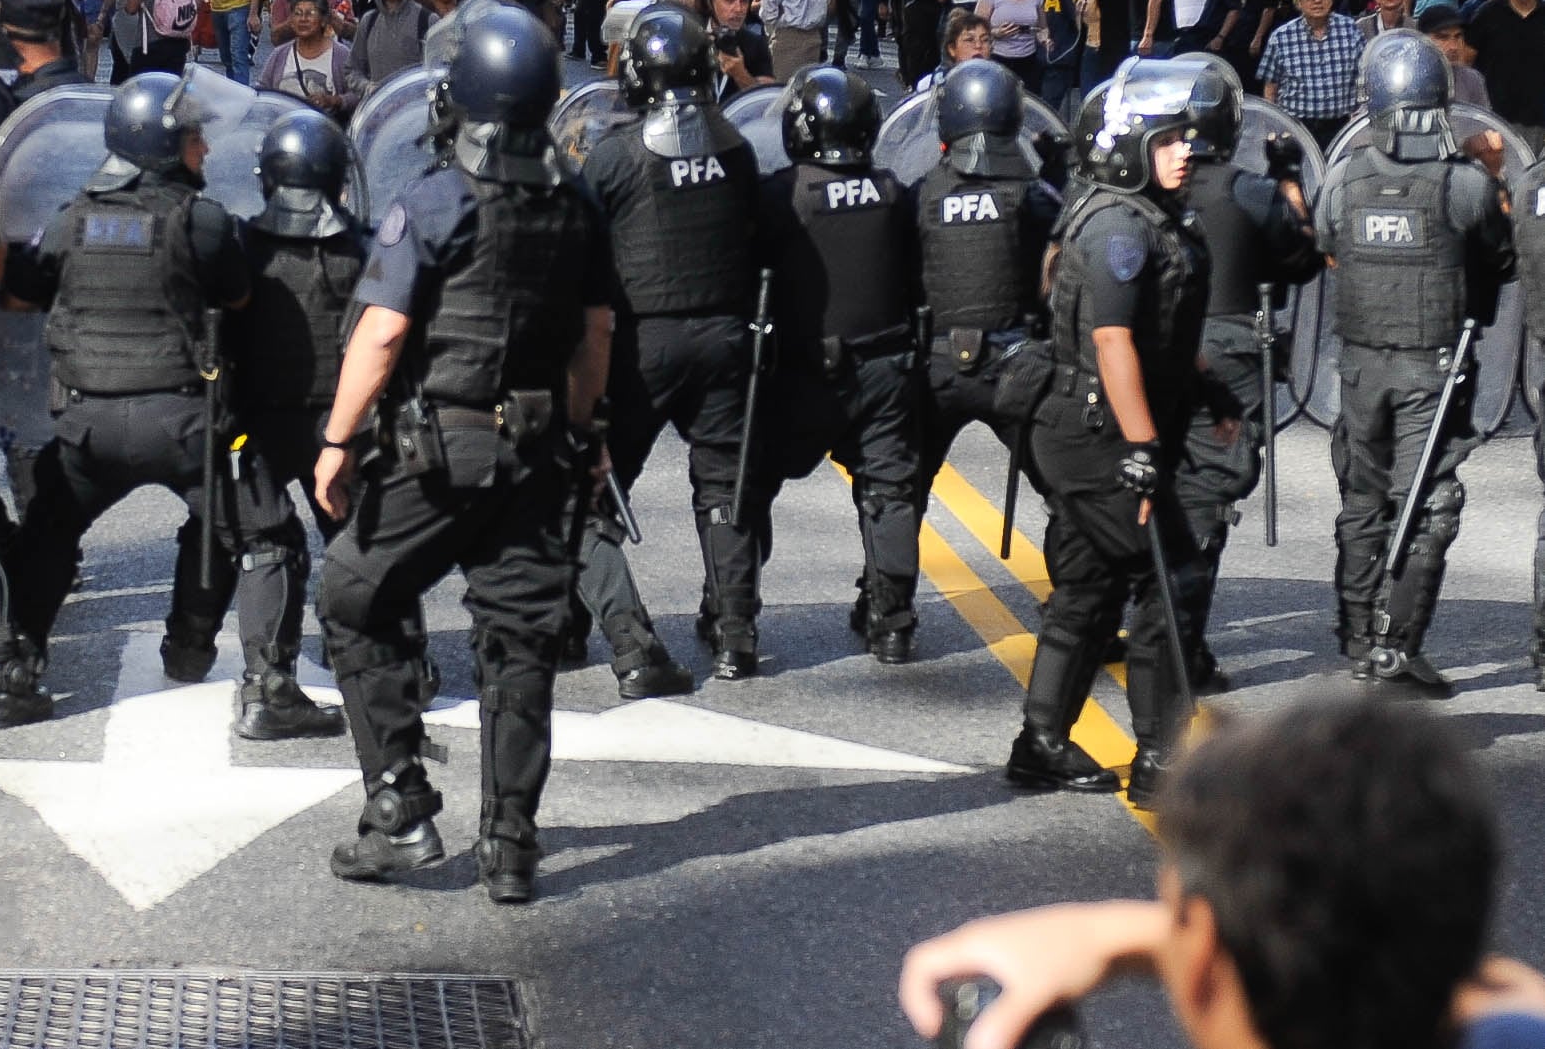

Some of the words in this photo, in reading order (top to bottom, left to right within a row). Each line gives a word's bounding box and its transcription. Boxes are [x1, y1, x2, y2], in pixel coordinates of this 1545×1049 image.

[670, 156, 726, 187] PFA
[826, 178, 880, 209] PFA
[943, 193, 1000, 223] PFA
[1365, 215, 1414, 242] PFA
